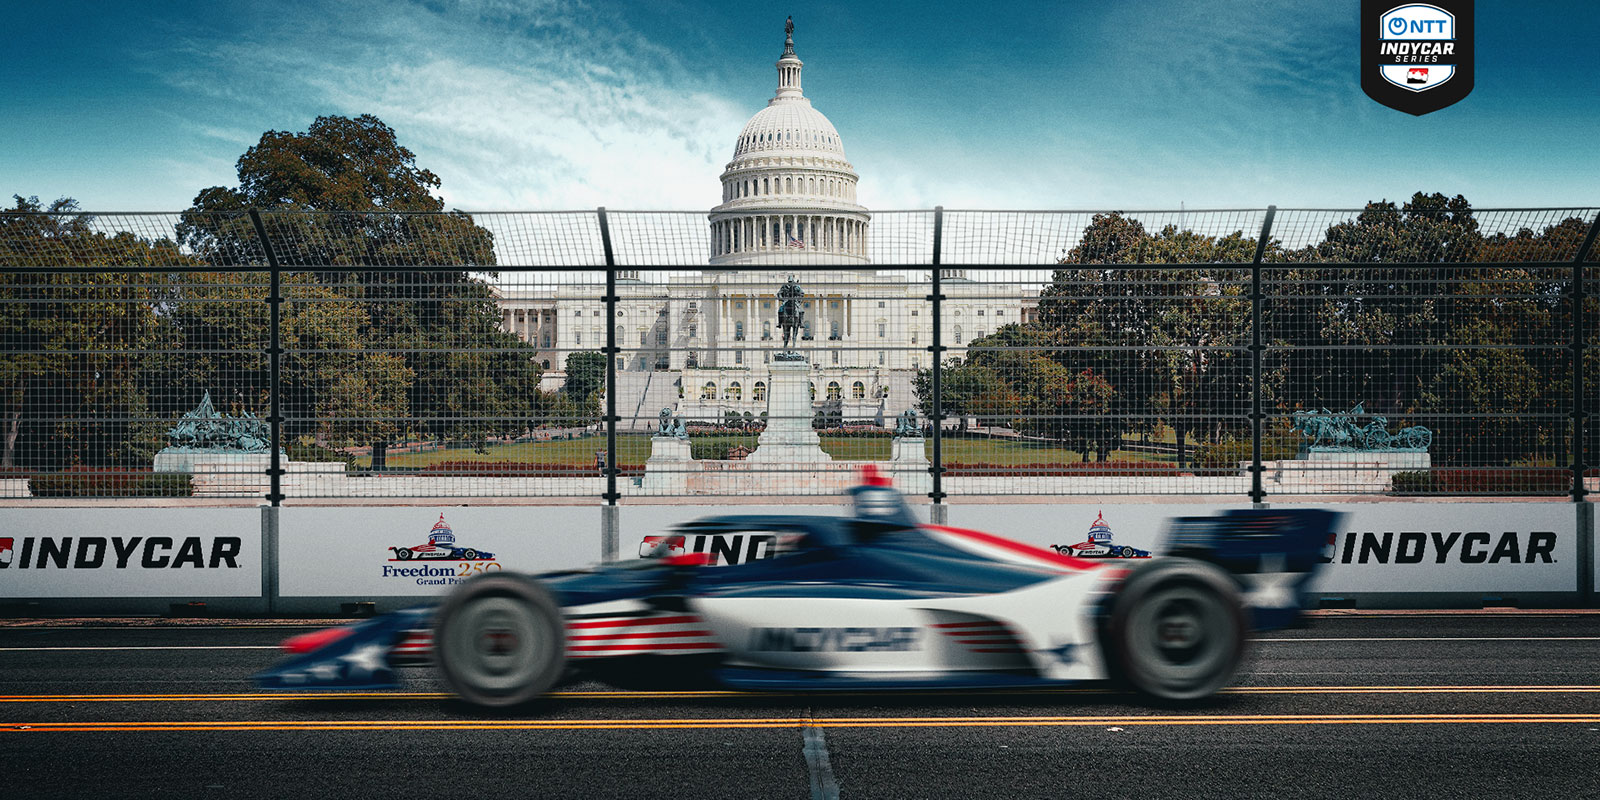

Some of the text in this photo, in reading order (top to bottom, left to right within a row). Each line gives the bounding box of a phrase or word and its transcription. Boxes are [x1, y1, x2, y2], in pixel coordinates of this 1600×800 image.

[19, 537, 241, 569] INDYCAR
[1341, 532, 1558, 564] INDYCAR
[382, 565, 456, 577] Freedom
